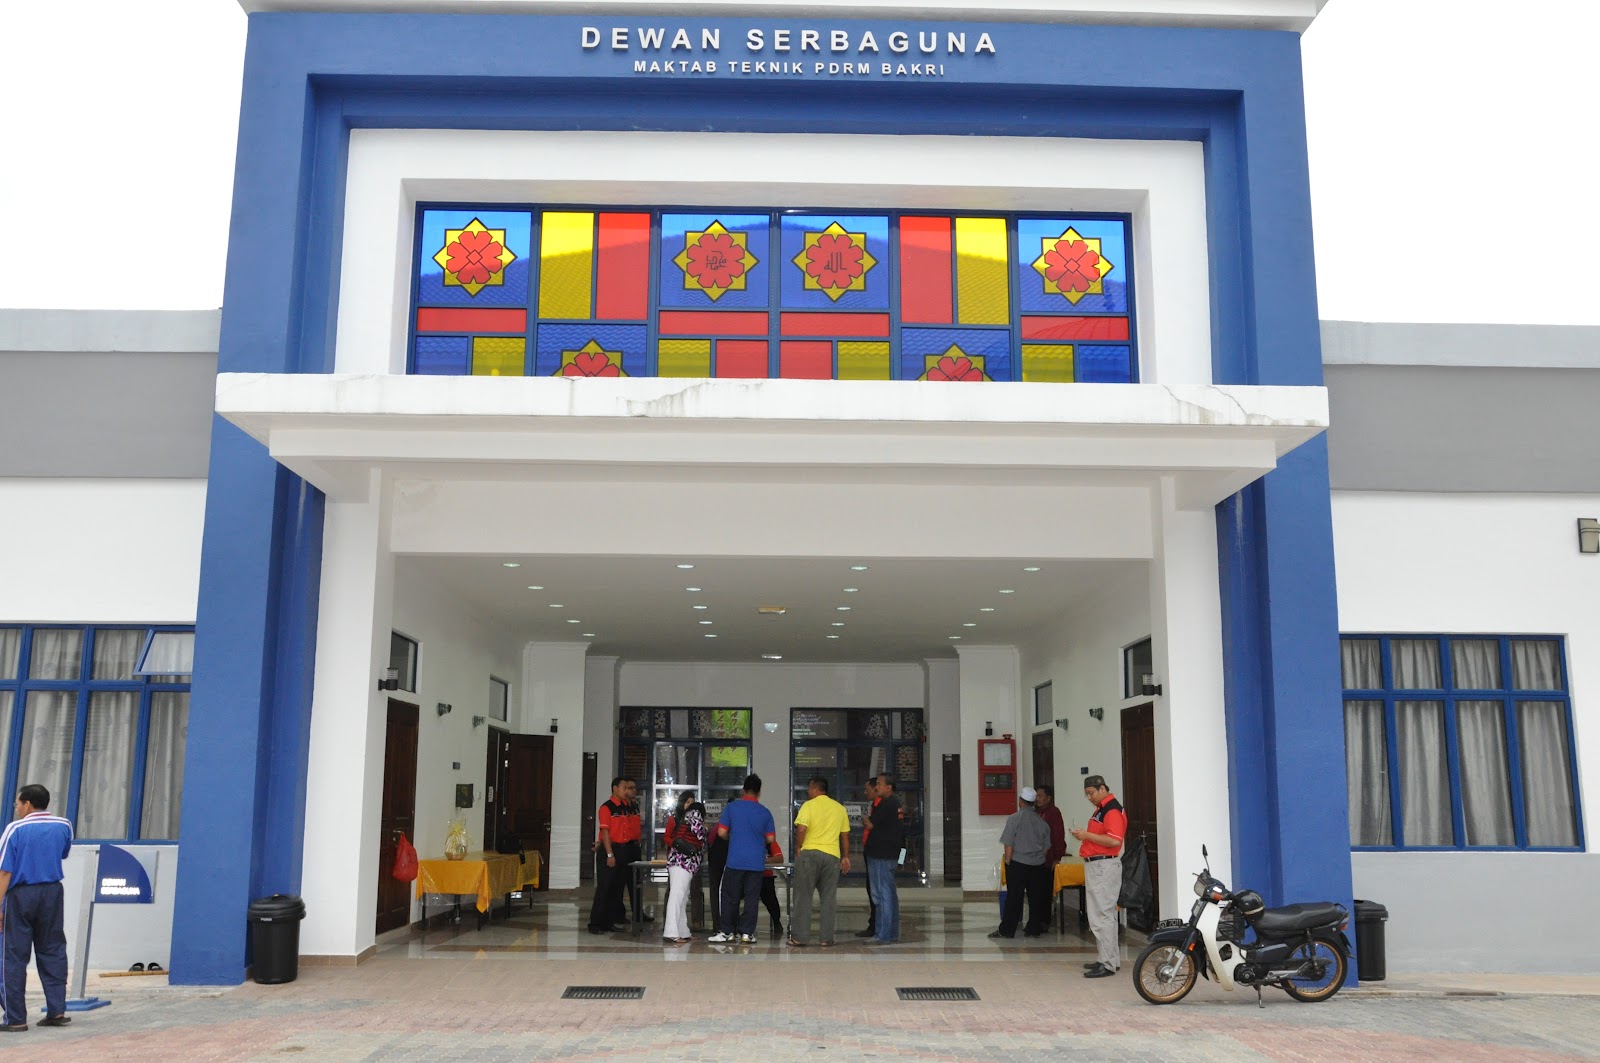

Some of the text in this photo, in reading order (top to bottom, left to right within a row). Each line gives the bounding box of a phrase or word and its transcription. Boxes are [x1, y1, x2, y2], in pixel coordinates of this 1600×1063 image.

[581, 26, 997, 54] DEWAN SERBAGUNA
[634, 60, 945, 76] MAKTAB TEKNIK PDRM BAKRI
